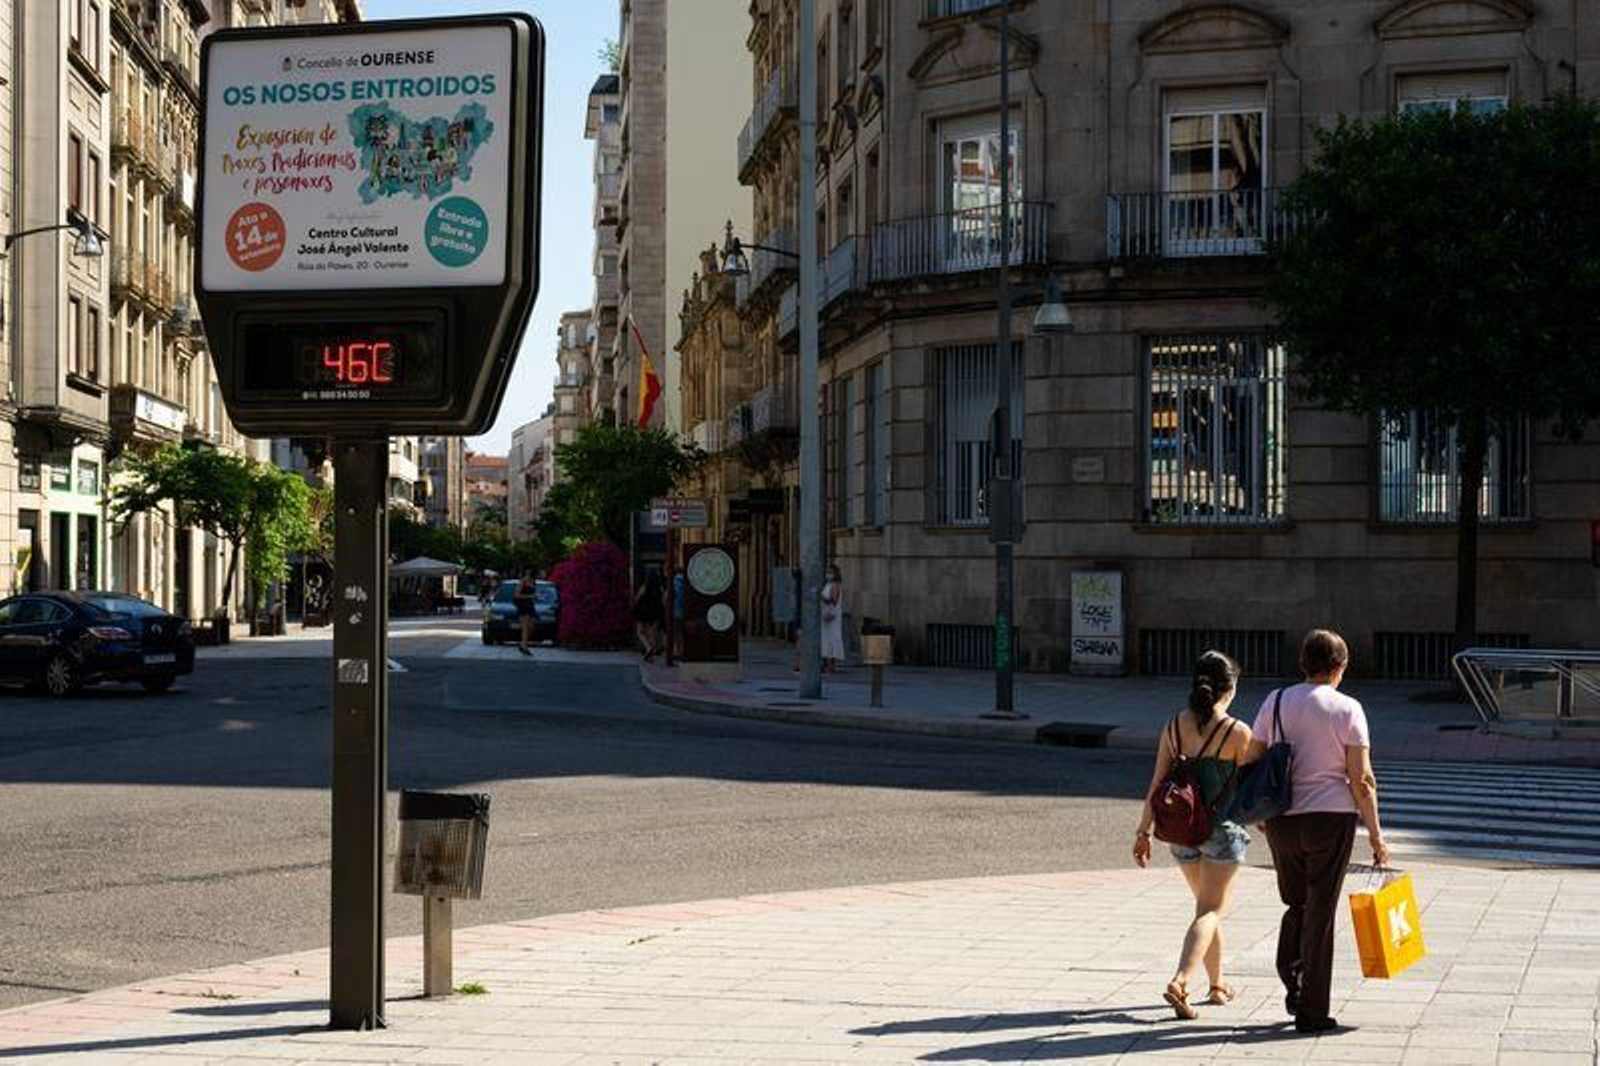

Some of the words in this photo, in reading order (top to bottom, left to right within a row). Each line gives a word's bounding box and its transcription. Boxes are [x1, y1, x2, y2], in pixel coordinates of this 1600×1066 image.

[297, 57, 343, 69] Concello
[346, 57, 359, 67] de
[360, 50, 435, 67] OURENSE
[223, 86, 256, 106] OS
[260, 81, 346, 105] NOSOS
[350, 74, 497, 100] ENTROIDOS
[319, 121, 337, 146] de
[254, 175, 333, 196] personaxes
[437, 207, 482, 229] Entrada
[234, 224, 263, 251] 14
[308, 227, 348, 239] Centro
[350, 226, 399, 239] Cultural
[297, 243, 325, 255] José
[327, 241, 362, 258] Ángel
[363, 242, 410, 254] Valente
[1388, 899, 1412, 943] K
